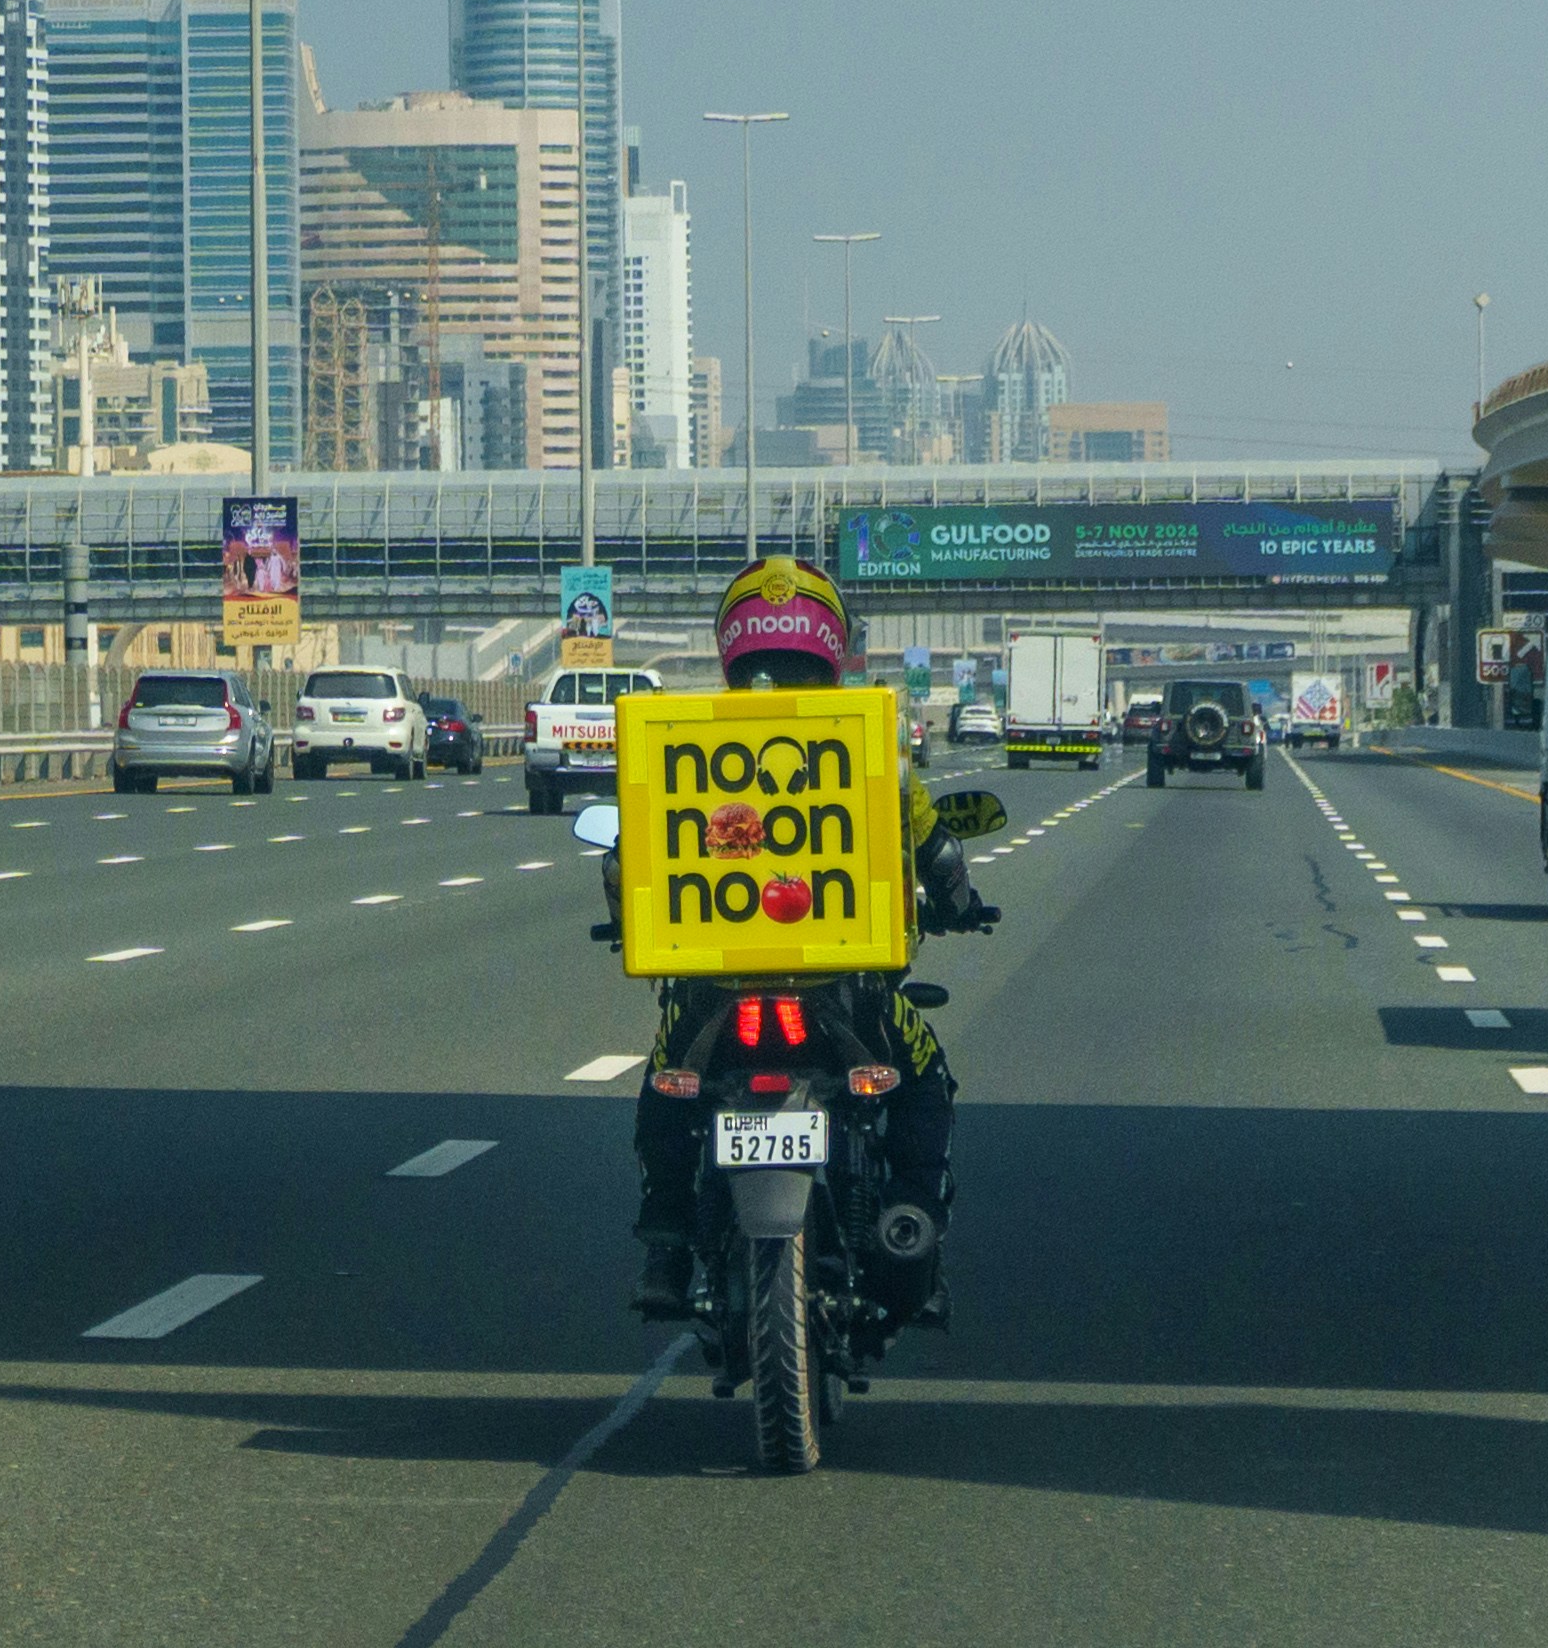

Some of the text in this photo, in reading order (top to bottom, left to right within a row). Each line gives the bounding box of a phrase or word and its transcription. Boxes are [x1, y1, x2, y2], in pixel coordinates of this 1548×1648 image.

[931, 524, 1051, 545] GULFOOD
[1075, 524, 1199, 539] 5-7 NOV 2024
[1269, 524, 1290, 536] من
[931, 547, 1051, 562] MANUFACTURING
[1260, 540, 1376, 555] 10 EPIC YEARS
[858, 562, 921, 576] EDITION
[1282, 575, 1350, 584] HYPERMEDIA
[747, 615, 811, 635] noon
[810, 1115, 818, 1130] 2
[730, 1135, 811, 1162] 52785
